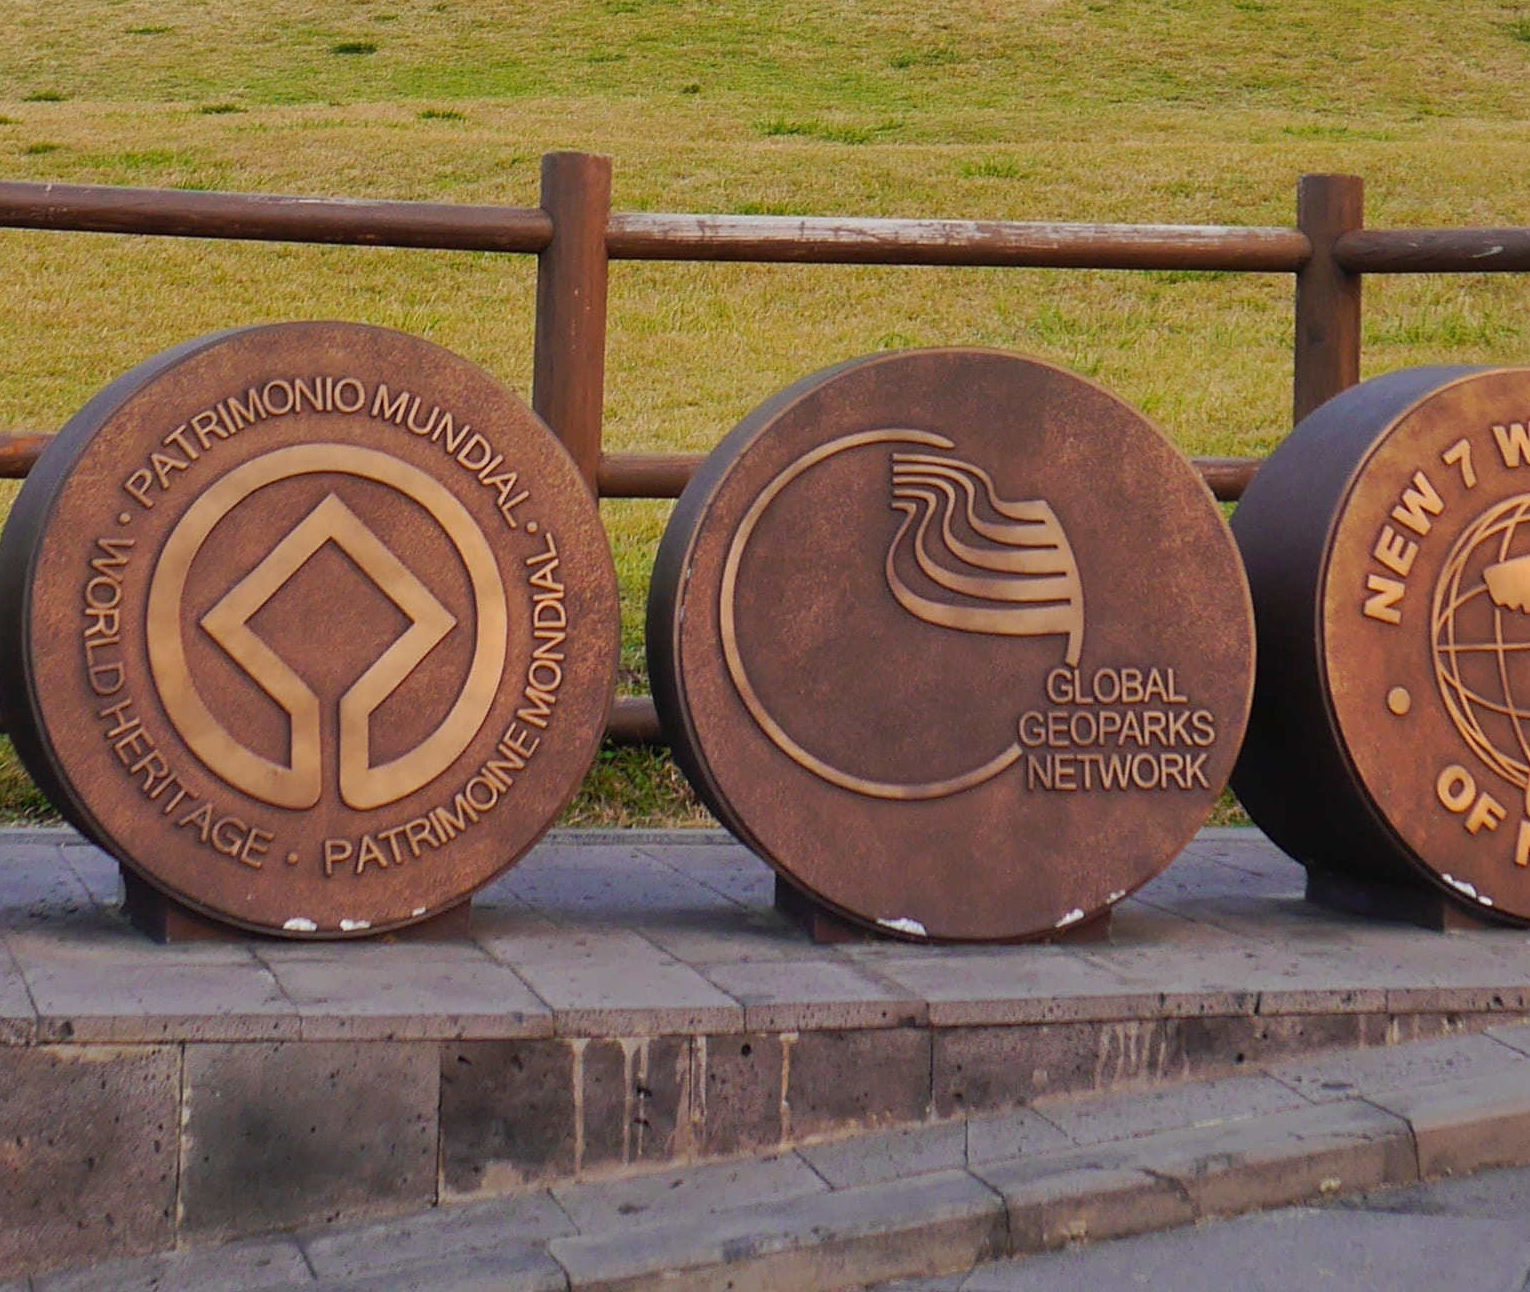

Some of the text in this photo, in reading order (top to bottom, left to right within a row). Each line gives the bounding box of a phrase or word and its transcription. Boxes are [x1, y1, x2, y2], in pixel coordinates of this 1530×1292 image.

[123, 376, 530, 529] PATRIMONIO MUNDIAL
[1363, 470, 1445, 626] NEW
[1443, 438, 1479, 490] 7
[82, 536, 275, 870] WORLD HERITAGE
[324, 532, 569, 876] PATRIMOINE MONDIAL
[1018, 710, 1216, 748] GEOPARKS
[1046, 668, 1188, 705] GLOBAL
[1028, 753, 1210, 791] NETWORK
[1436, 763, 1507, 836] OF
